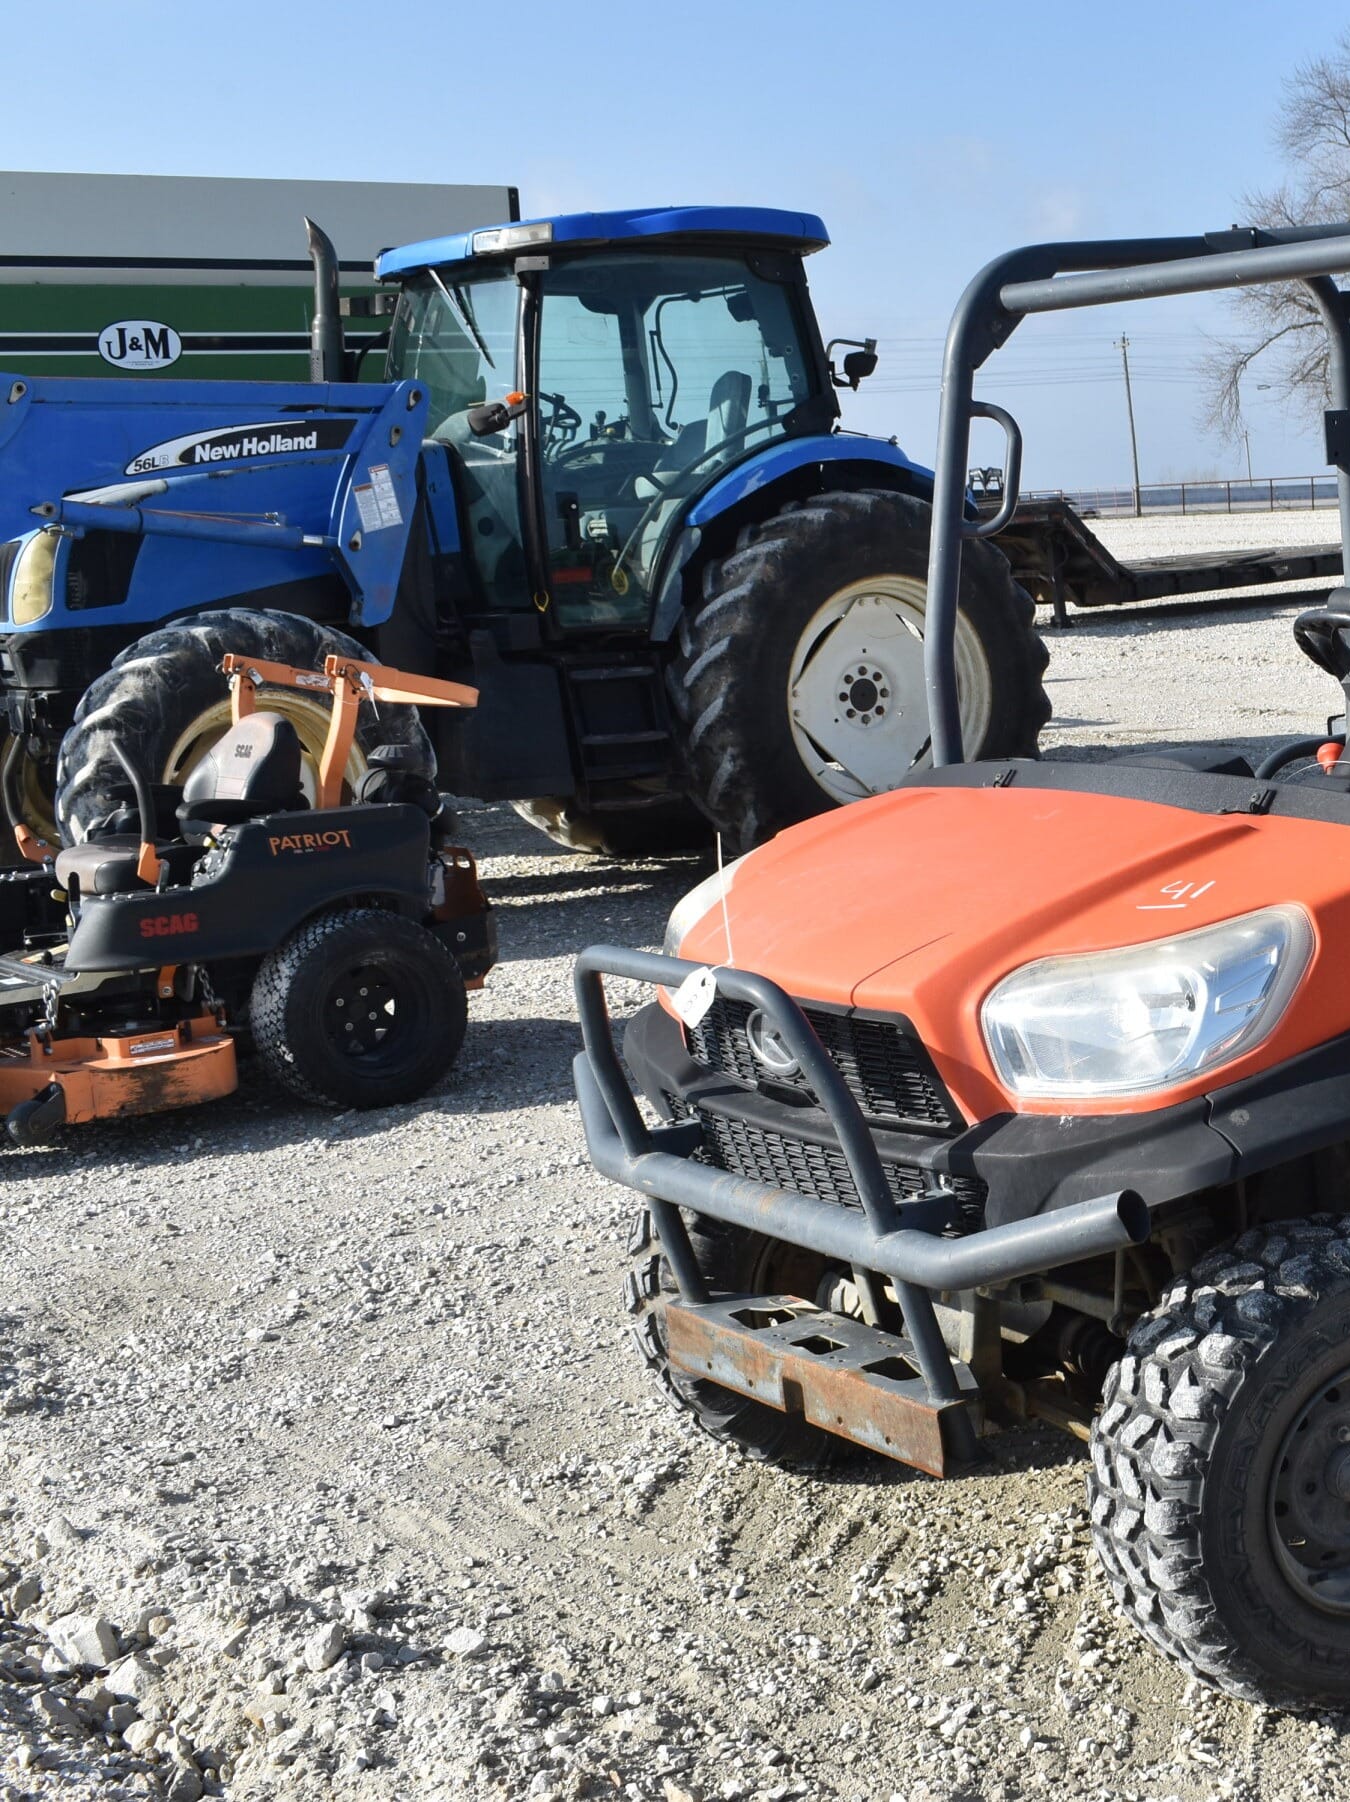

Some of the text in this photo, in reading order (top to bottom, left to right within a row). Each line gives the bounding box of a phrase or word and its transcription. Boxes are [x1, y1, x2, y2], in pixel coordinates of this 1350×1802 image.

[104, 327, 174, 360] J&M
[194, 442, 242, 464] New
[242, 431, 317, 456] Holland
[268, 829, 352, 857] PATRIOT
[140, 911, 199, 938] SCAG
